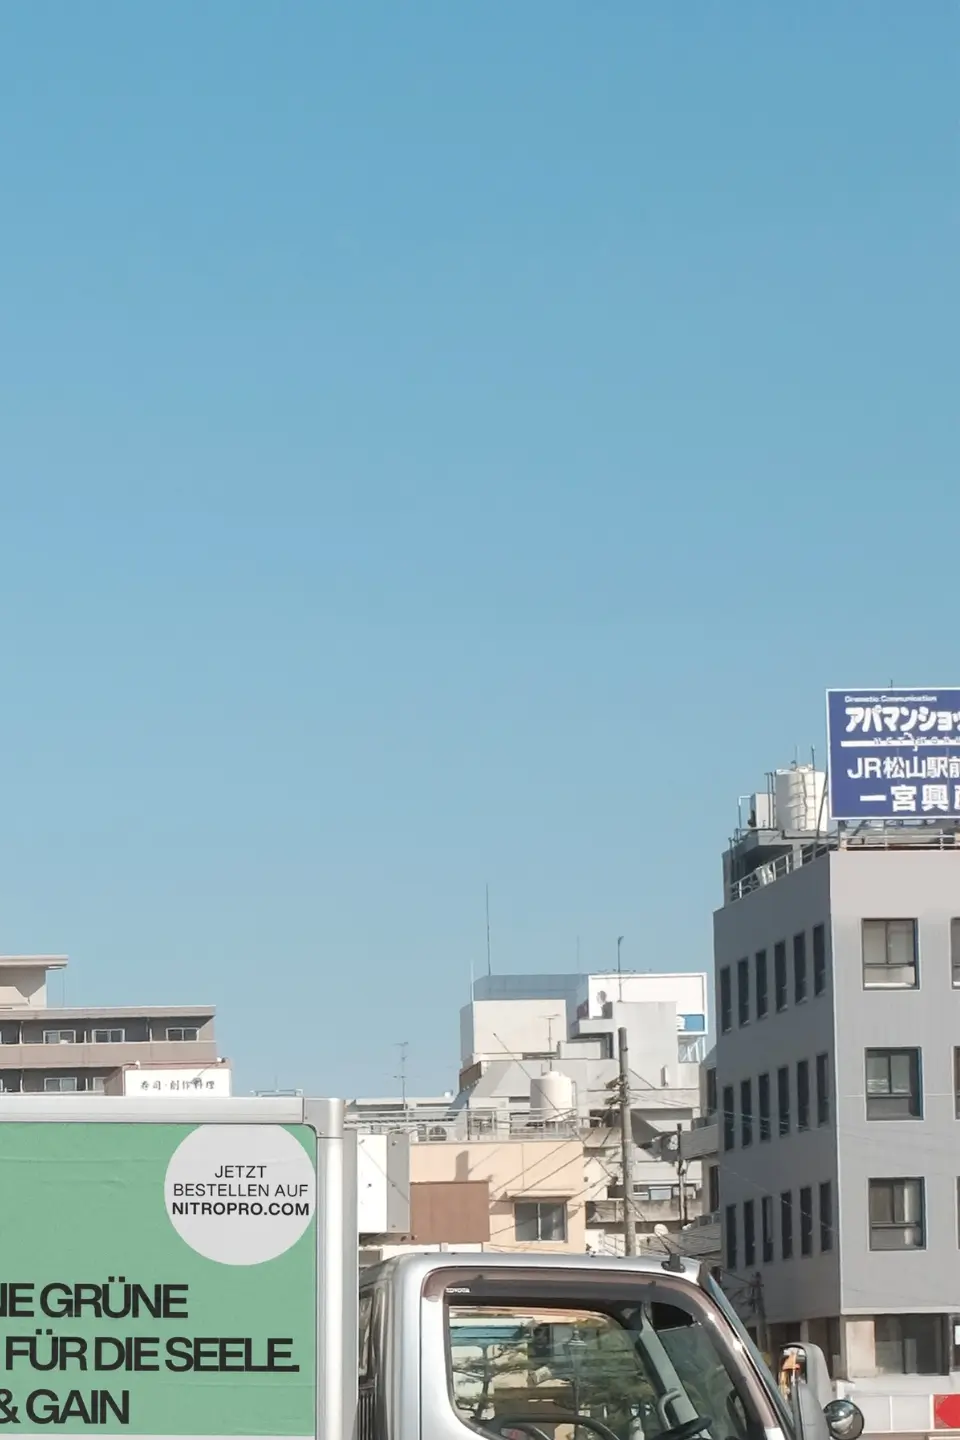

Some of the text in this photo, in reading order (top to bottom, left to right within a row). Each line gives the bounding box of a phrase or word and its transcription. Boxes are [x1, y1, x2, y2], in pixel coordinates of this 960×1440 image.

[214, 1165, 267, 1179] JETZT
[173, 1183, 309, 1198] BESTELLEN AUF
[172, 1202, 310, 1217] NITROPRO.COM
[39, 1276, 189, 1319] GRÜNE
[5, 1329, 88, 1371] FÜR
[94, 1336, 160, 1371] DIE
[164, 1336, 300, 1373] SEELE.
[25, 1388, 130, 1424] GAIN
